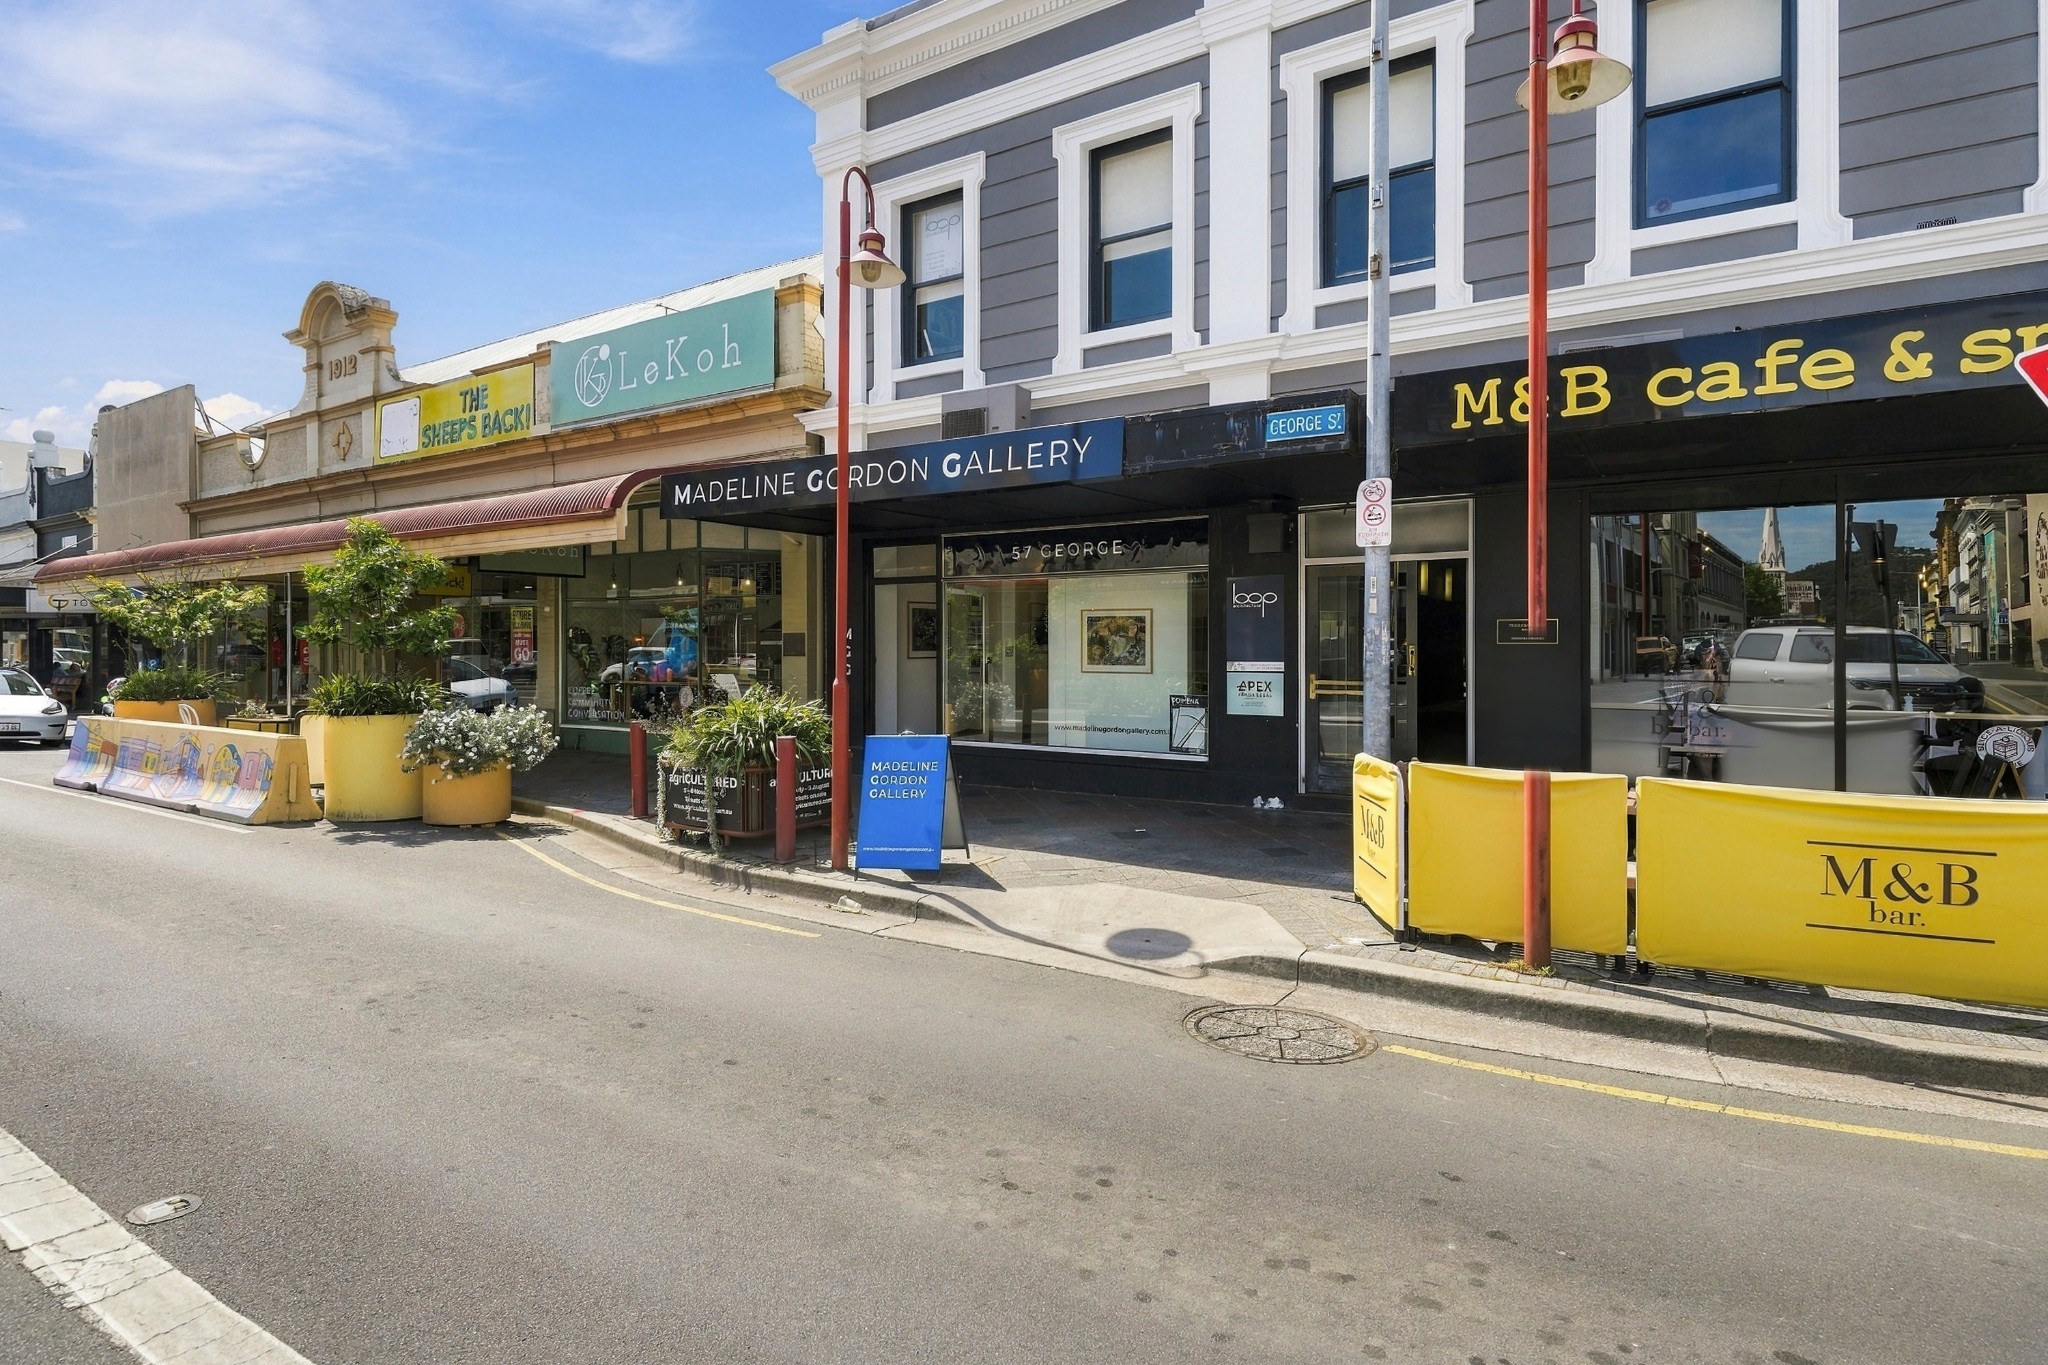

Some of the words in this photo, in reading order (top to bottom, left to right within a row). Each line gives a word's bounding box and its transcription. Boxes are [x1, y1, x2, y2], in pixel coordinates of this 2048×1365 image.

[329, 354, 357, 381] 1912
[618, 323, 742, 390] LeKoh
[1646, 338, 1855, 407] cafe
[1883, 330, 1933, 382] &
[459, 384, 488, 414] THE
[422, 415, 477, 448] SHEEPS
[482, 403, 530, 438] BACK!
[1270, 415, 1322, 435] GEORGE
[674, 472, 795, 505] MADELINE
[806, 456, 929, 492] GORDON
[942, 436, 1092, 478] GALLERY
[1012, 546, 1031, 560] 57
[1040, 540, 1123, 558] GEORGE
[1233, 583, 1277, 617] loop
[514, 648, 530, 661] GO
[1237, 681, 1272, 692] APEX
[568, 708, 625, 720] CONVERSATION
[871, 761, 938, 771] MADELINE
[669, 773, 738, 789] agriCULTRED
[870, 775, 927, 785] GORDON
[869, 789, 926, 799] GALLERY
[1361, 805, 1385, 849] M&B
[1820, 854, 1979, 906] M&B
[1868, 900, 1926, 927] bar.
